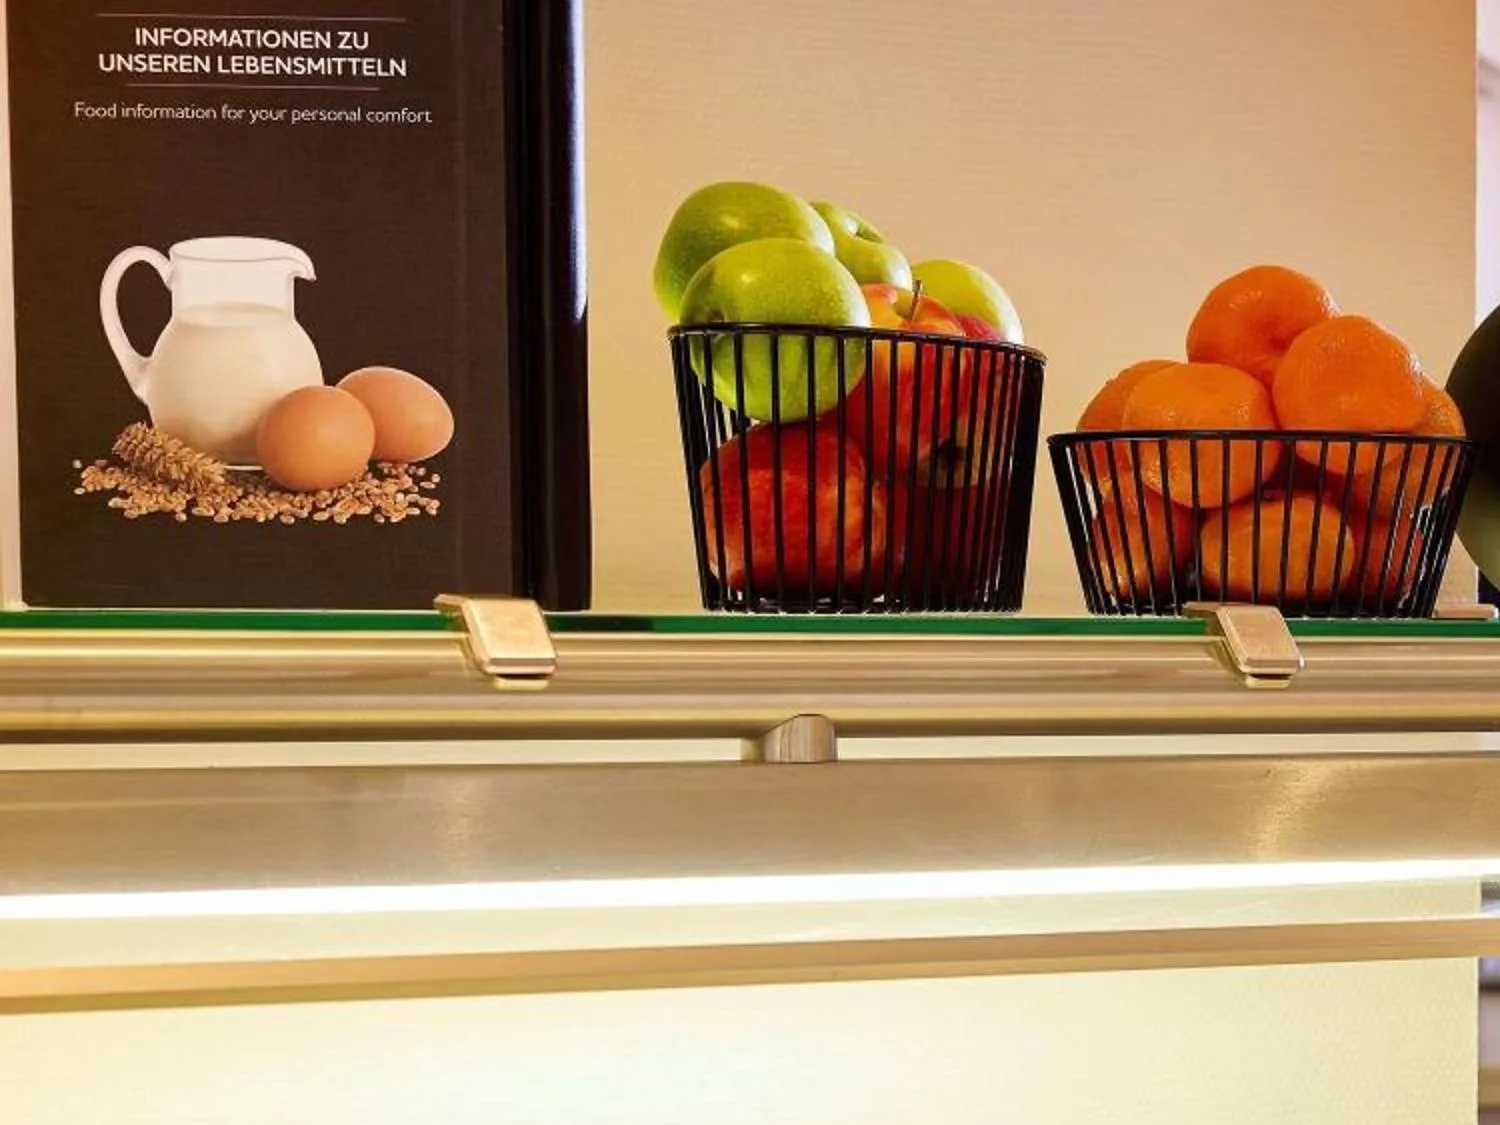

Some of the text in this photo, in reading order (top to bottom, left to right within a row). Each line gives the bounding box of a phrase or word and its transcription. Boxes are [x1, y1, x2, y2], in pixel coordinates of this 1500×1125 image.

[135, 27, 369, 50] INFORMATIONEN ZU
[98, 53, 407, 77] UNSEREN LEBENSMITTELN
[74, 101, 432, 125] Food information for your personal comfort
